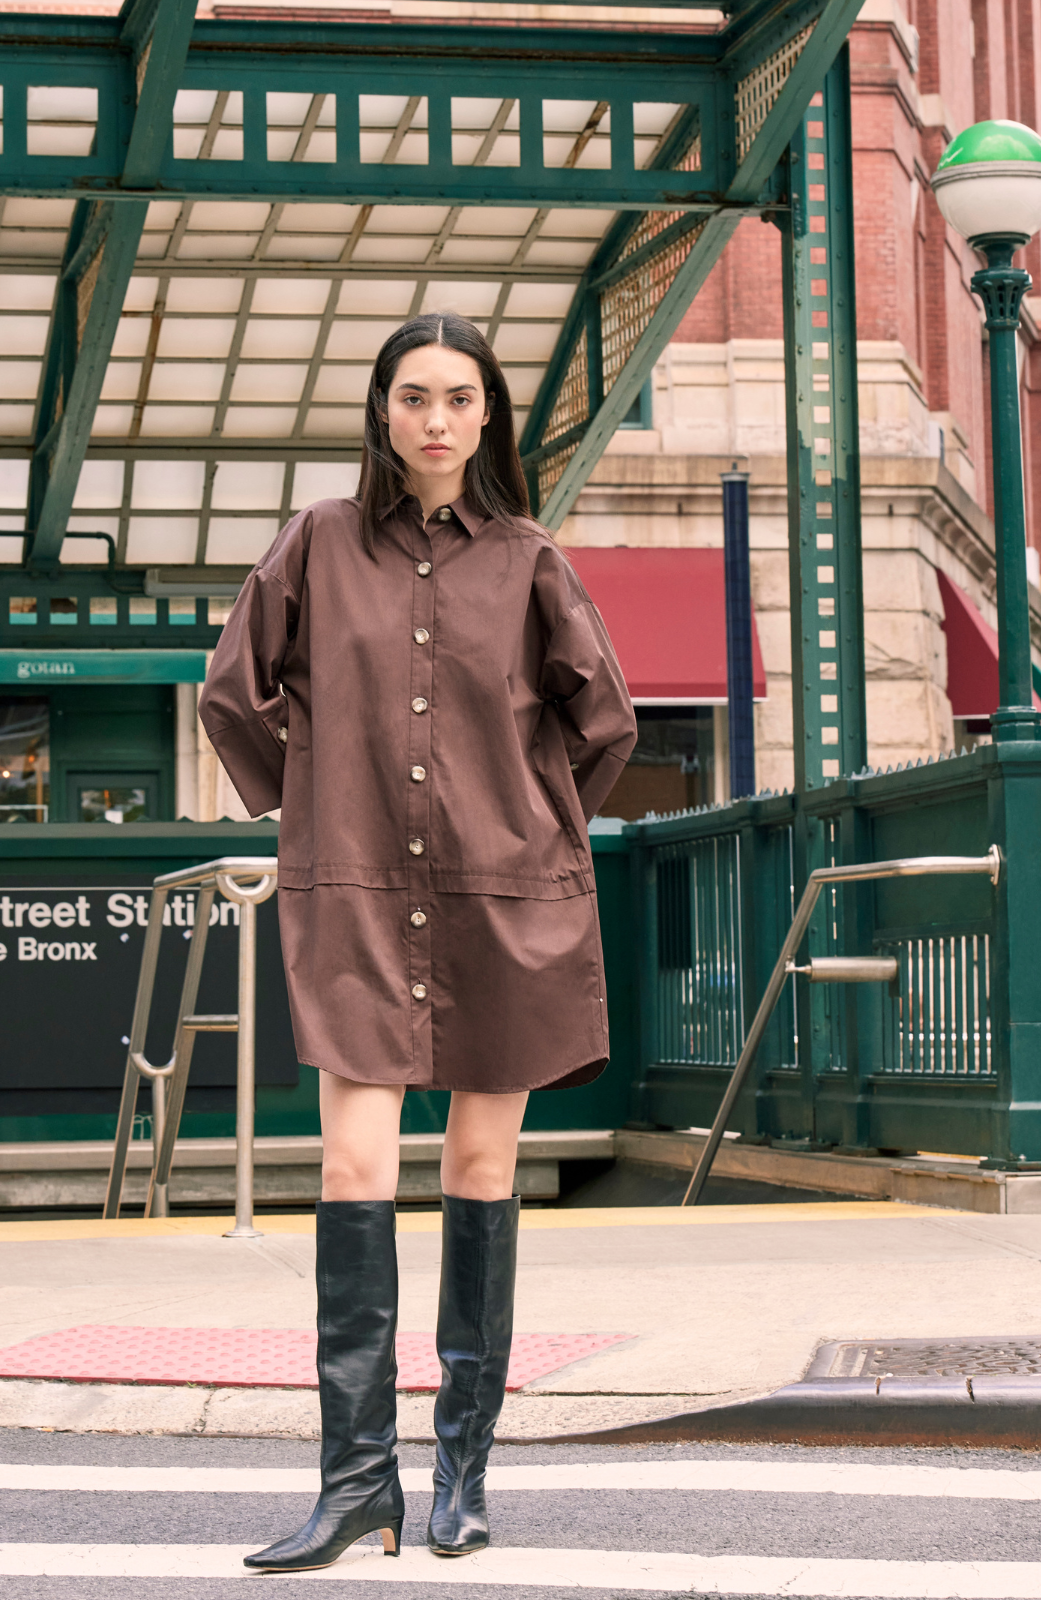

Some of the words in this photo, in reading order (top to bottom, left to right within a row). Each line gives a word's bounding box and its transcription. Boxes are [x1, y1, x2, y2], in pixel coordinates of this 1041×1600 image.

[17, 661, 75, 678] gotan
[0, 896, 91, 928] treet
[18, 937, 98, 961] Bronx
